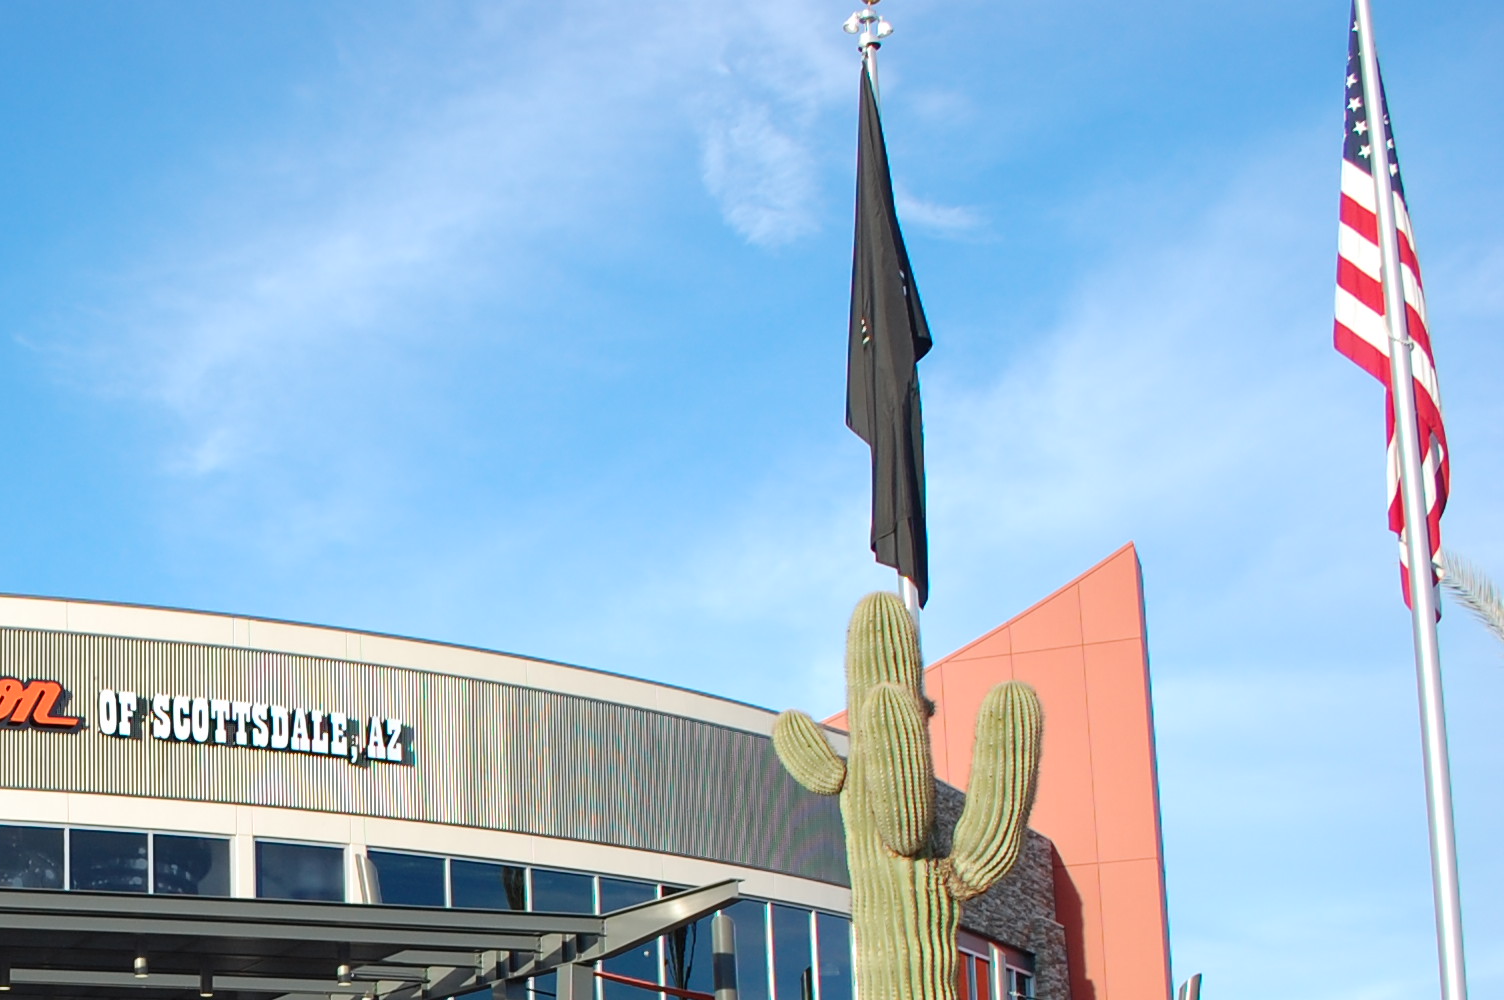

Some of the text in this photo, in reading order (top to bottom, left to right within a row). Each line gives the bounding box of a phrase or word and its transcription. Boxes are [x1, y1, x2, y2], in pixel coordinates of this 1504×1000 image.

[98, 689, 403, 764] OF SCOTTSDALE, AZ
